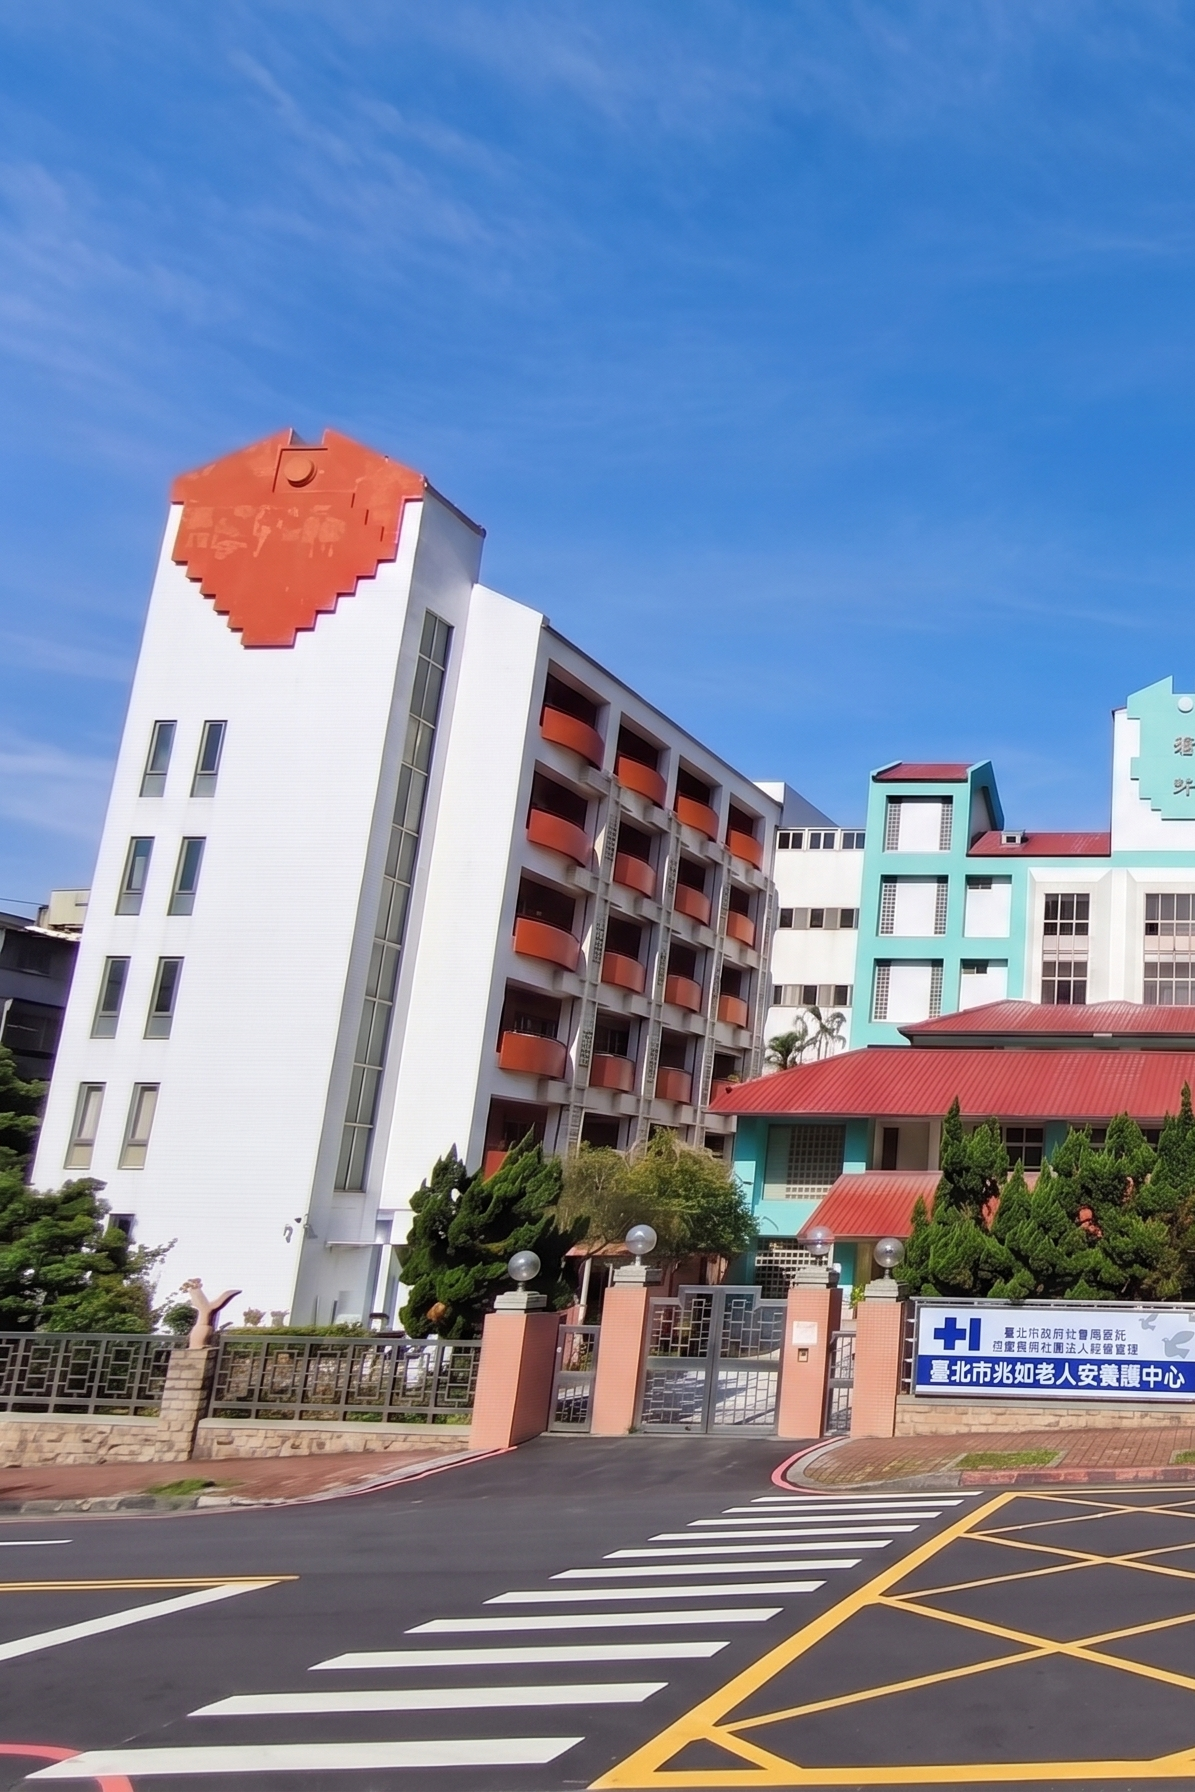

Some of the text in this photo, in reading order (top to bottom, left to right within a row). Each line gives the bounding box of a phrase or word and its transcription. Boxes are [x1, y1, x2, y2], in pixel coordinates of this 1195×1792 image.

[929, 1359, 1186, 1389] 臺北市兆如老人安養護中心
